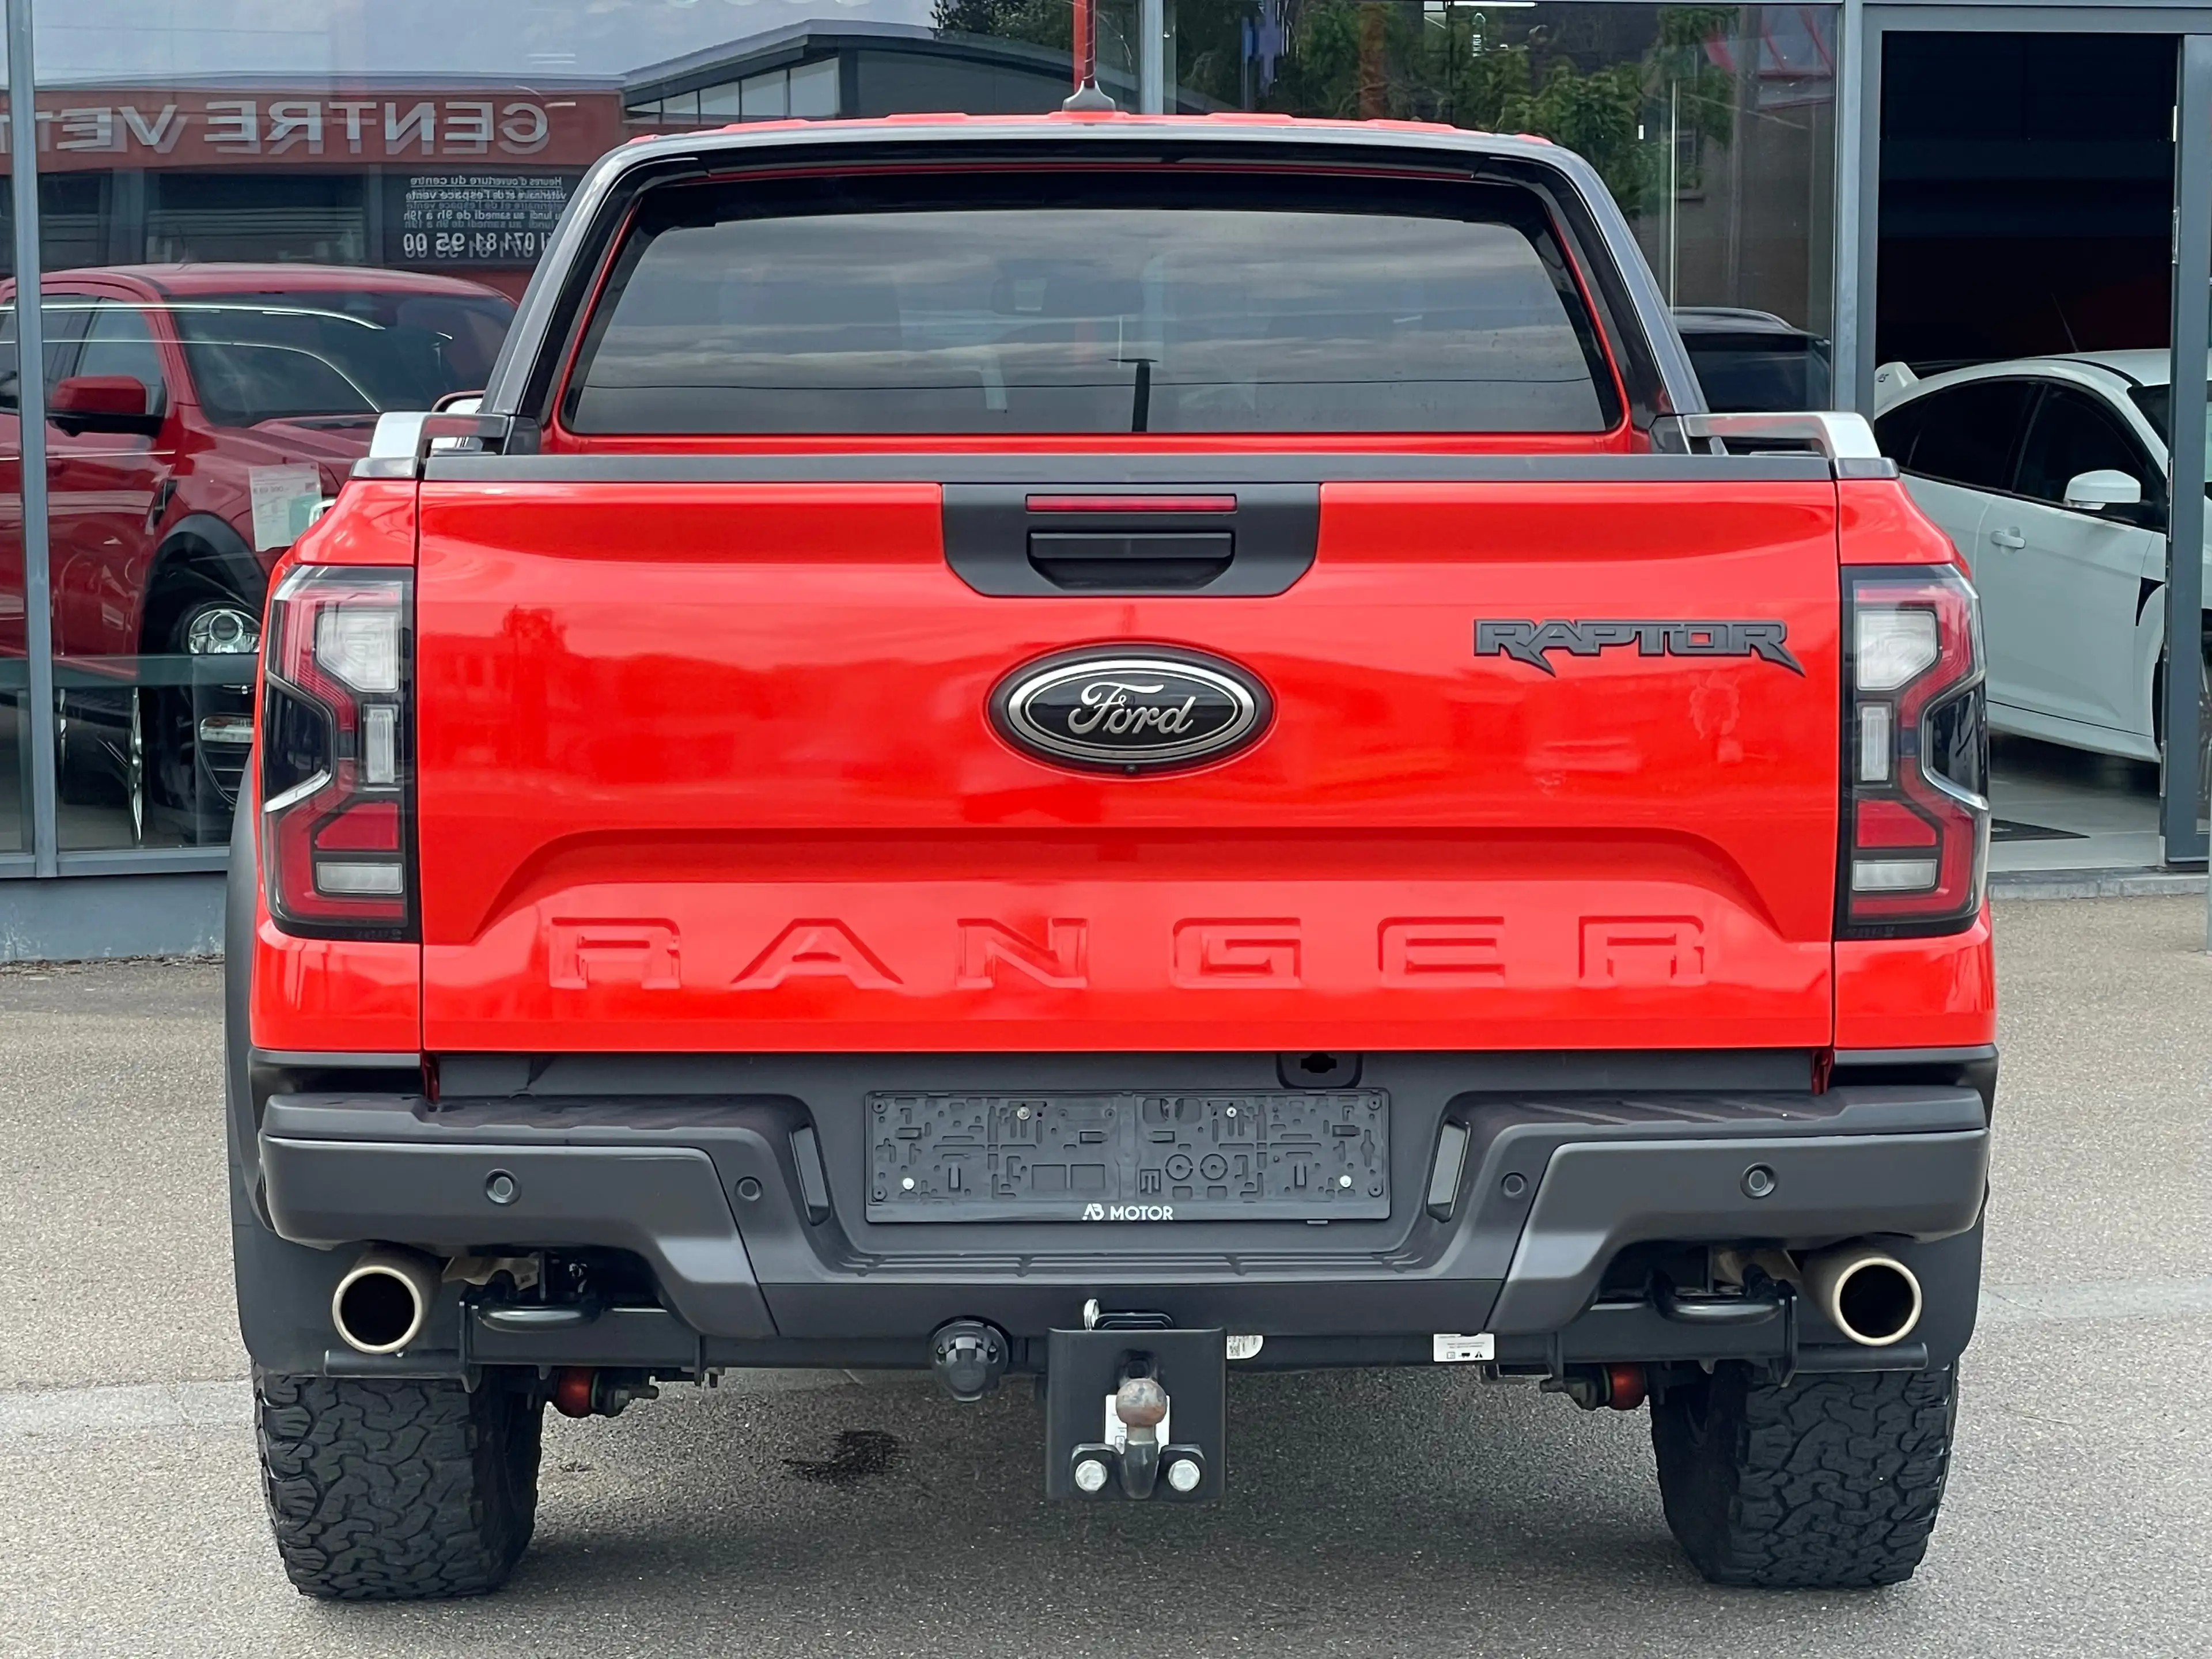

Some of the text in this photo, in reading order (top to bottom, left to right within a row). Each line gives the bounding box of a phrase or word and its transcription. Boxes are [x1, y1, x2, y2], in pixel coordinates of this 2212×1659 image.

[1474, 619, 1806, 677] RAPTOR
[1068, 681, 1196, 734] Ford
[549, 915, 1705, 990] RANGER
[1110, 1205, 1173, 1221] MOTOR
